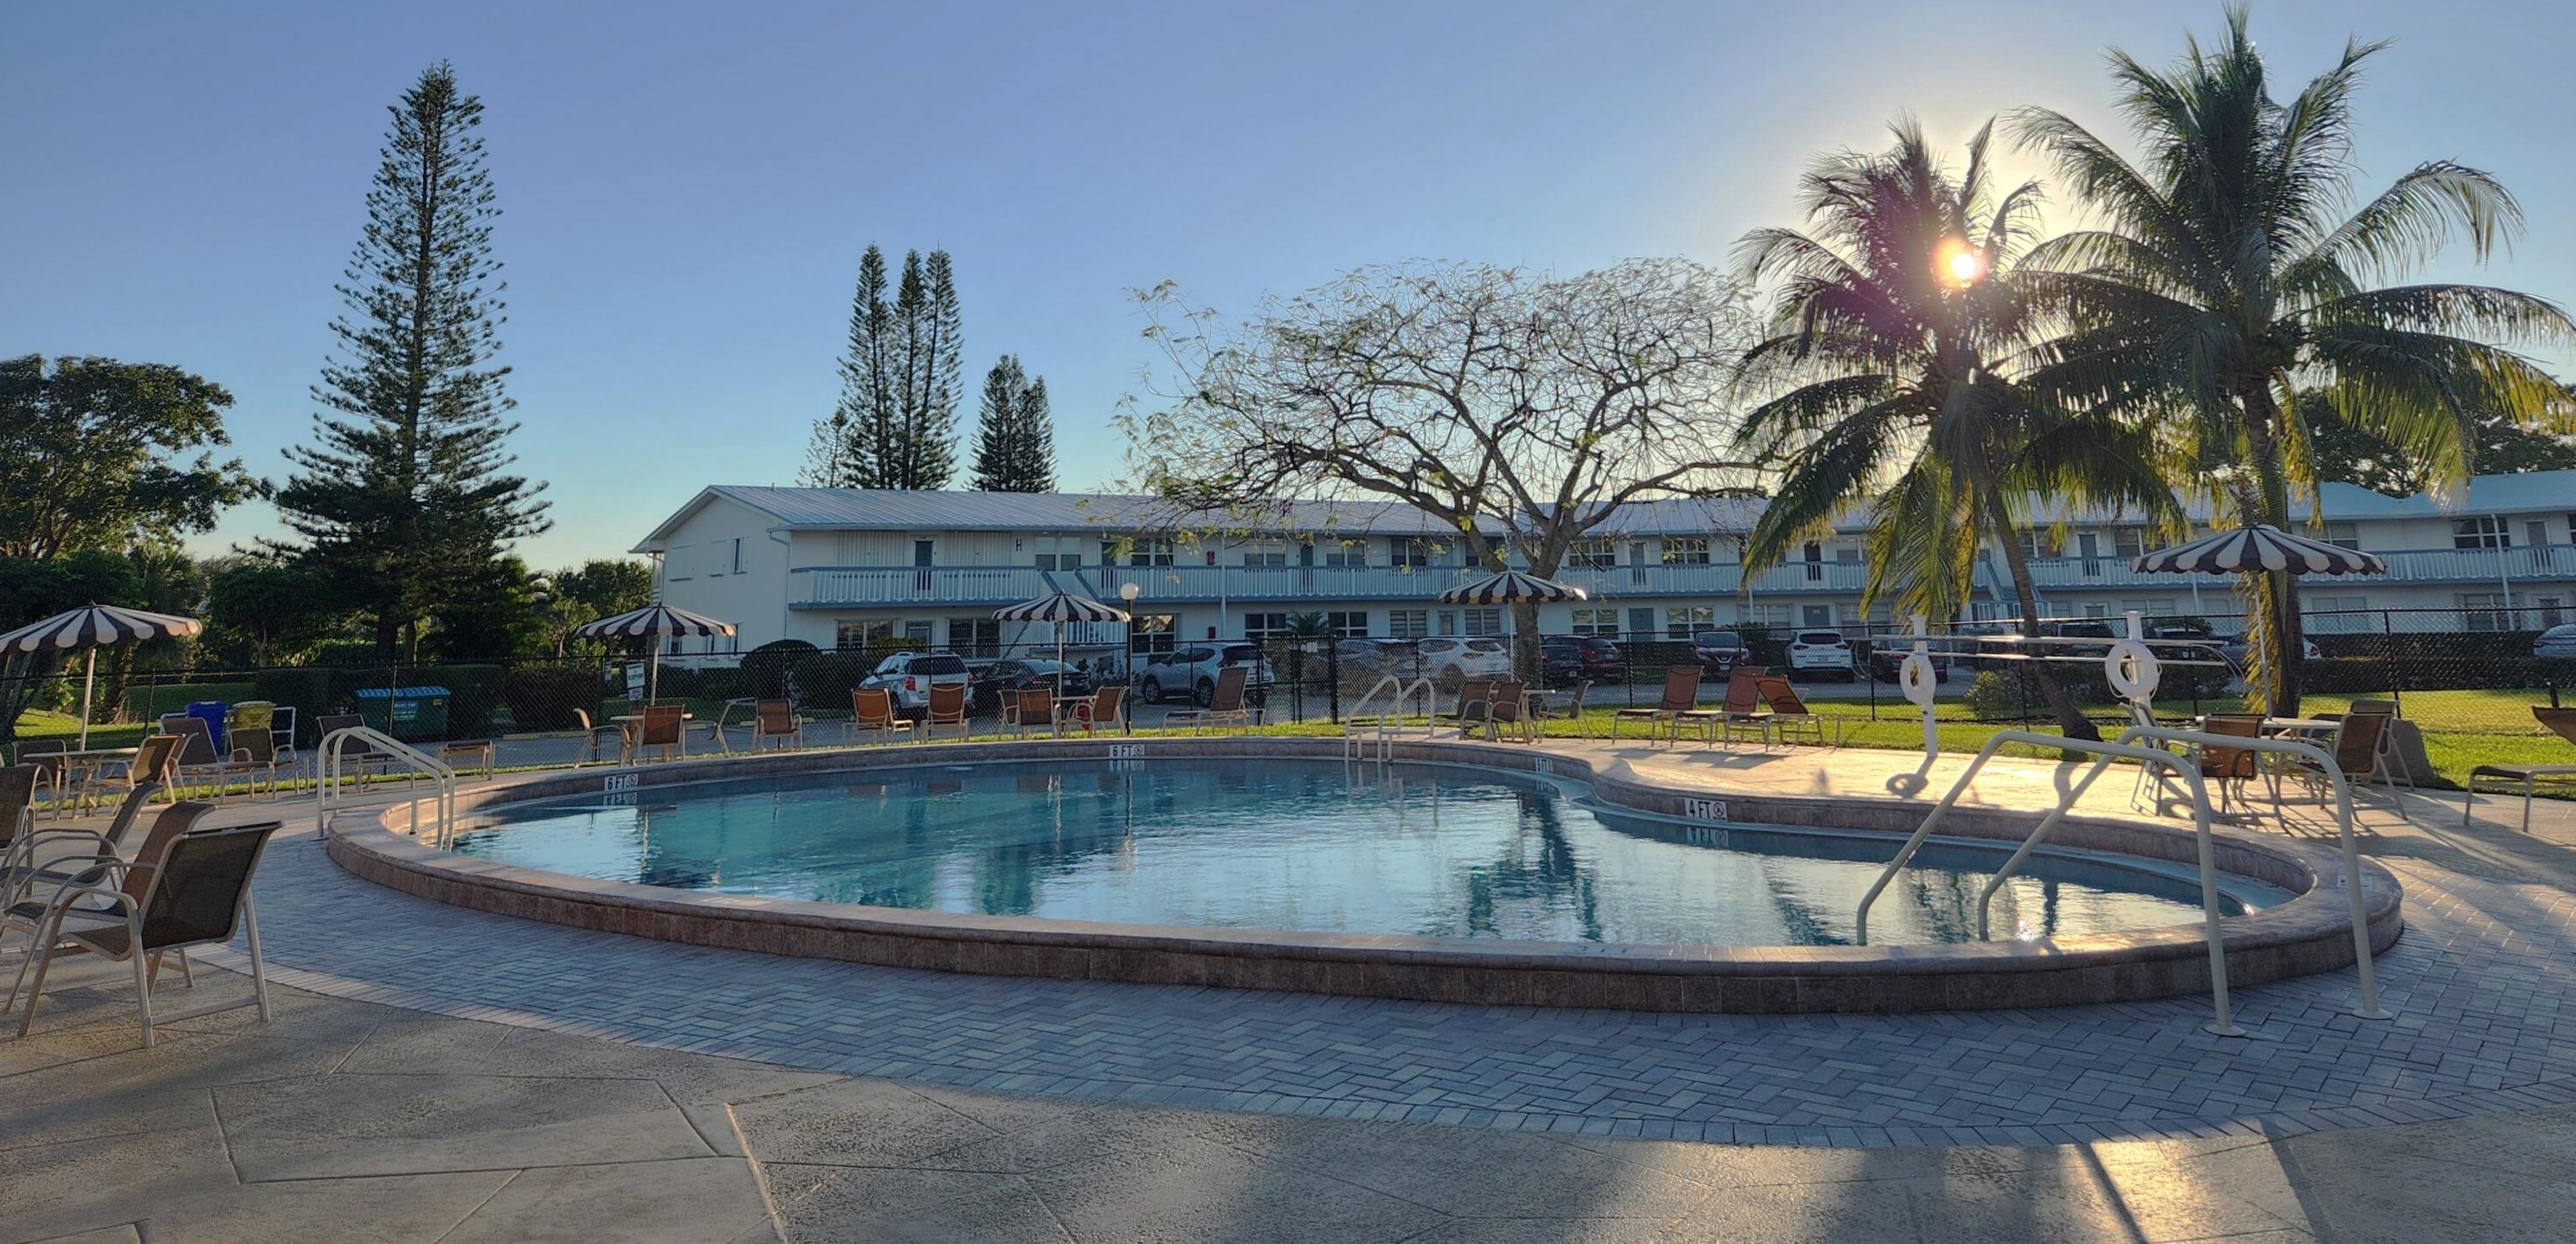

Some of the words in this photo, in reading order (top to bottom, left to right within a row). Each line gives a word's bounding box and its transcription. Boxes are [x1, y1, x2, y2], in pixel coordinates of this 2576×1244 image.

[1015, 538, 1022, 551] H
[1112, 745, 1118, 757] 6
[1121, 745, 1132, 757] FT
[608, 777, 613, 790] 6
[615, 776, 627, 789] FT
[1690, 800, 1696, 817] 4
[1698, 801, 1710, 819] FT
